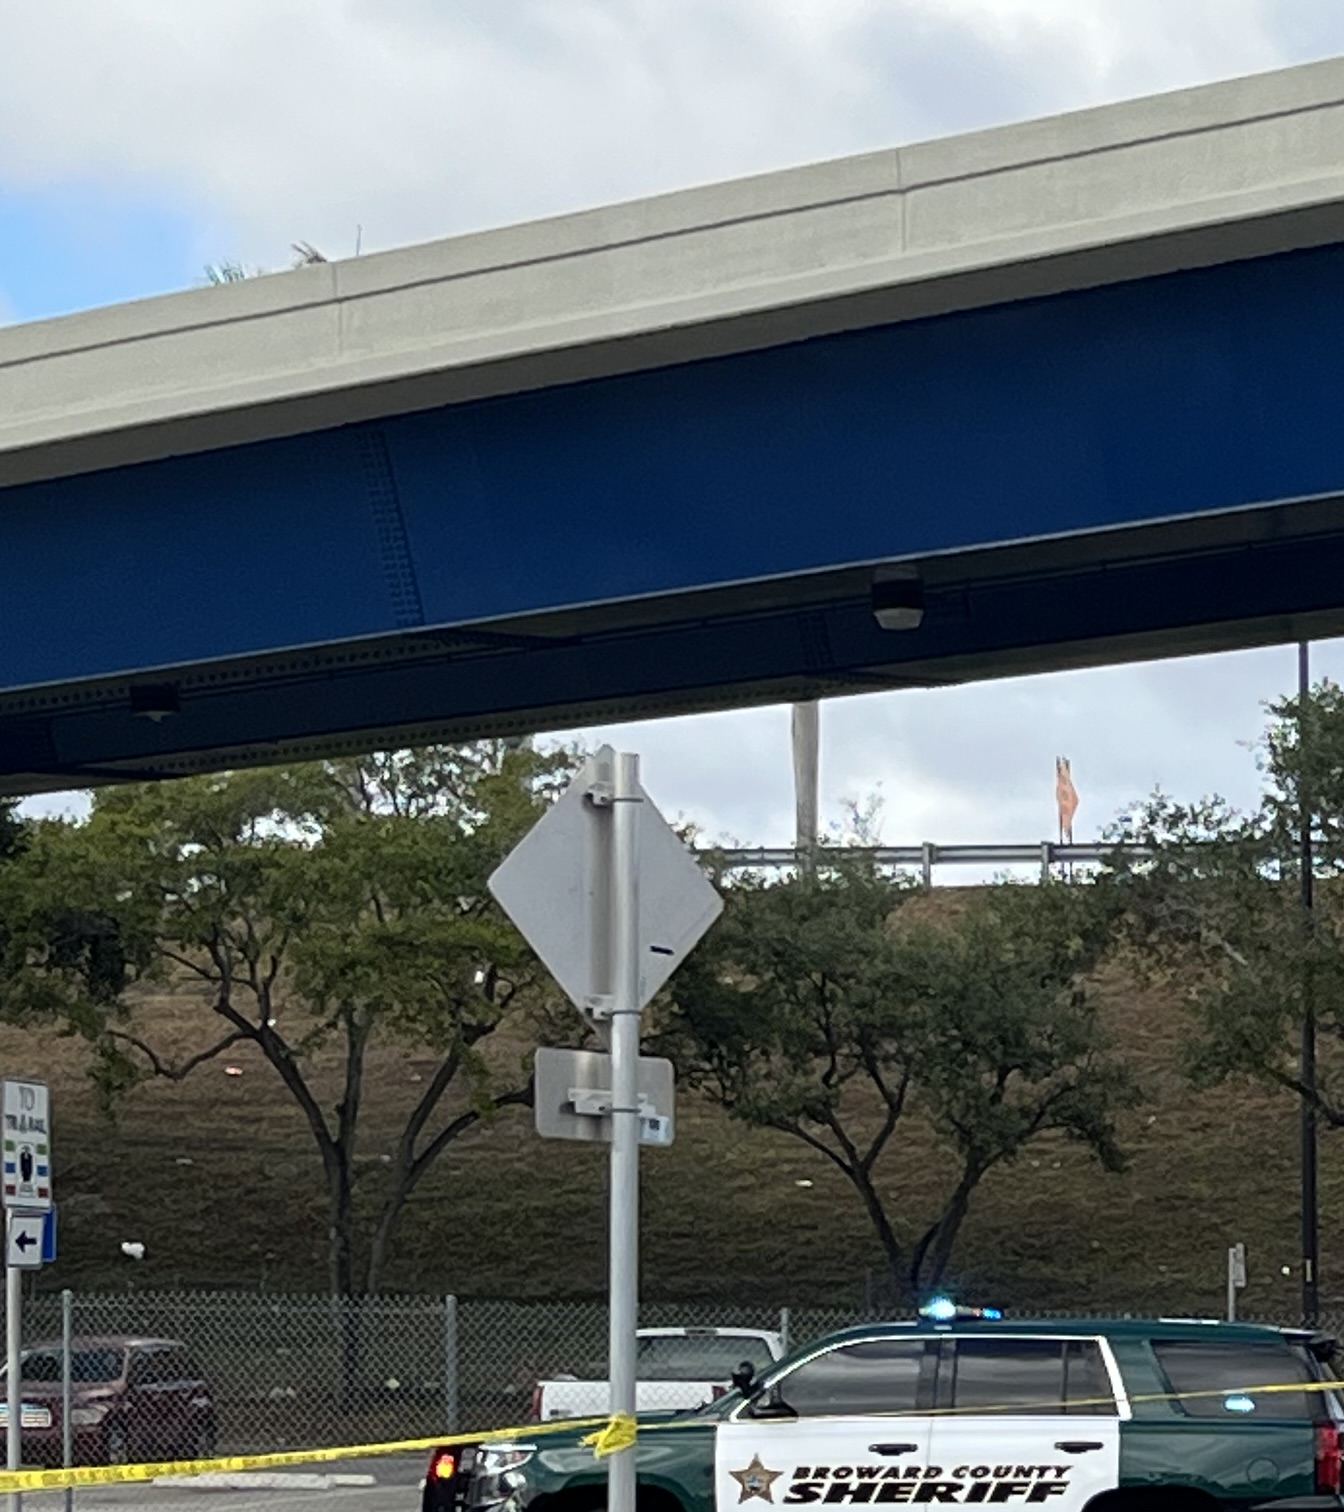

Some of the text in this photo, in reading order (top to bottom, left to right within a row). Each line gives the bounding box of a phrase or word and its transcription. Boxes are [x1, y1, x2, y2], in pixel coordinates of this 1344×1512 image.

[792, 1465, 1073, 1480] BROWARD COUNTY
[783, 1481, 1071, 1504] SHERIFF
